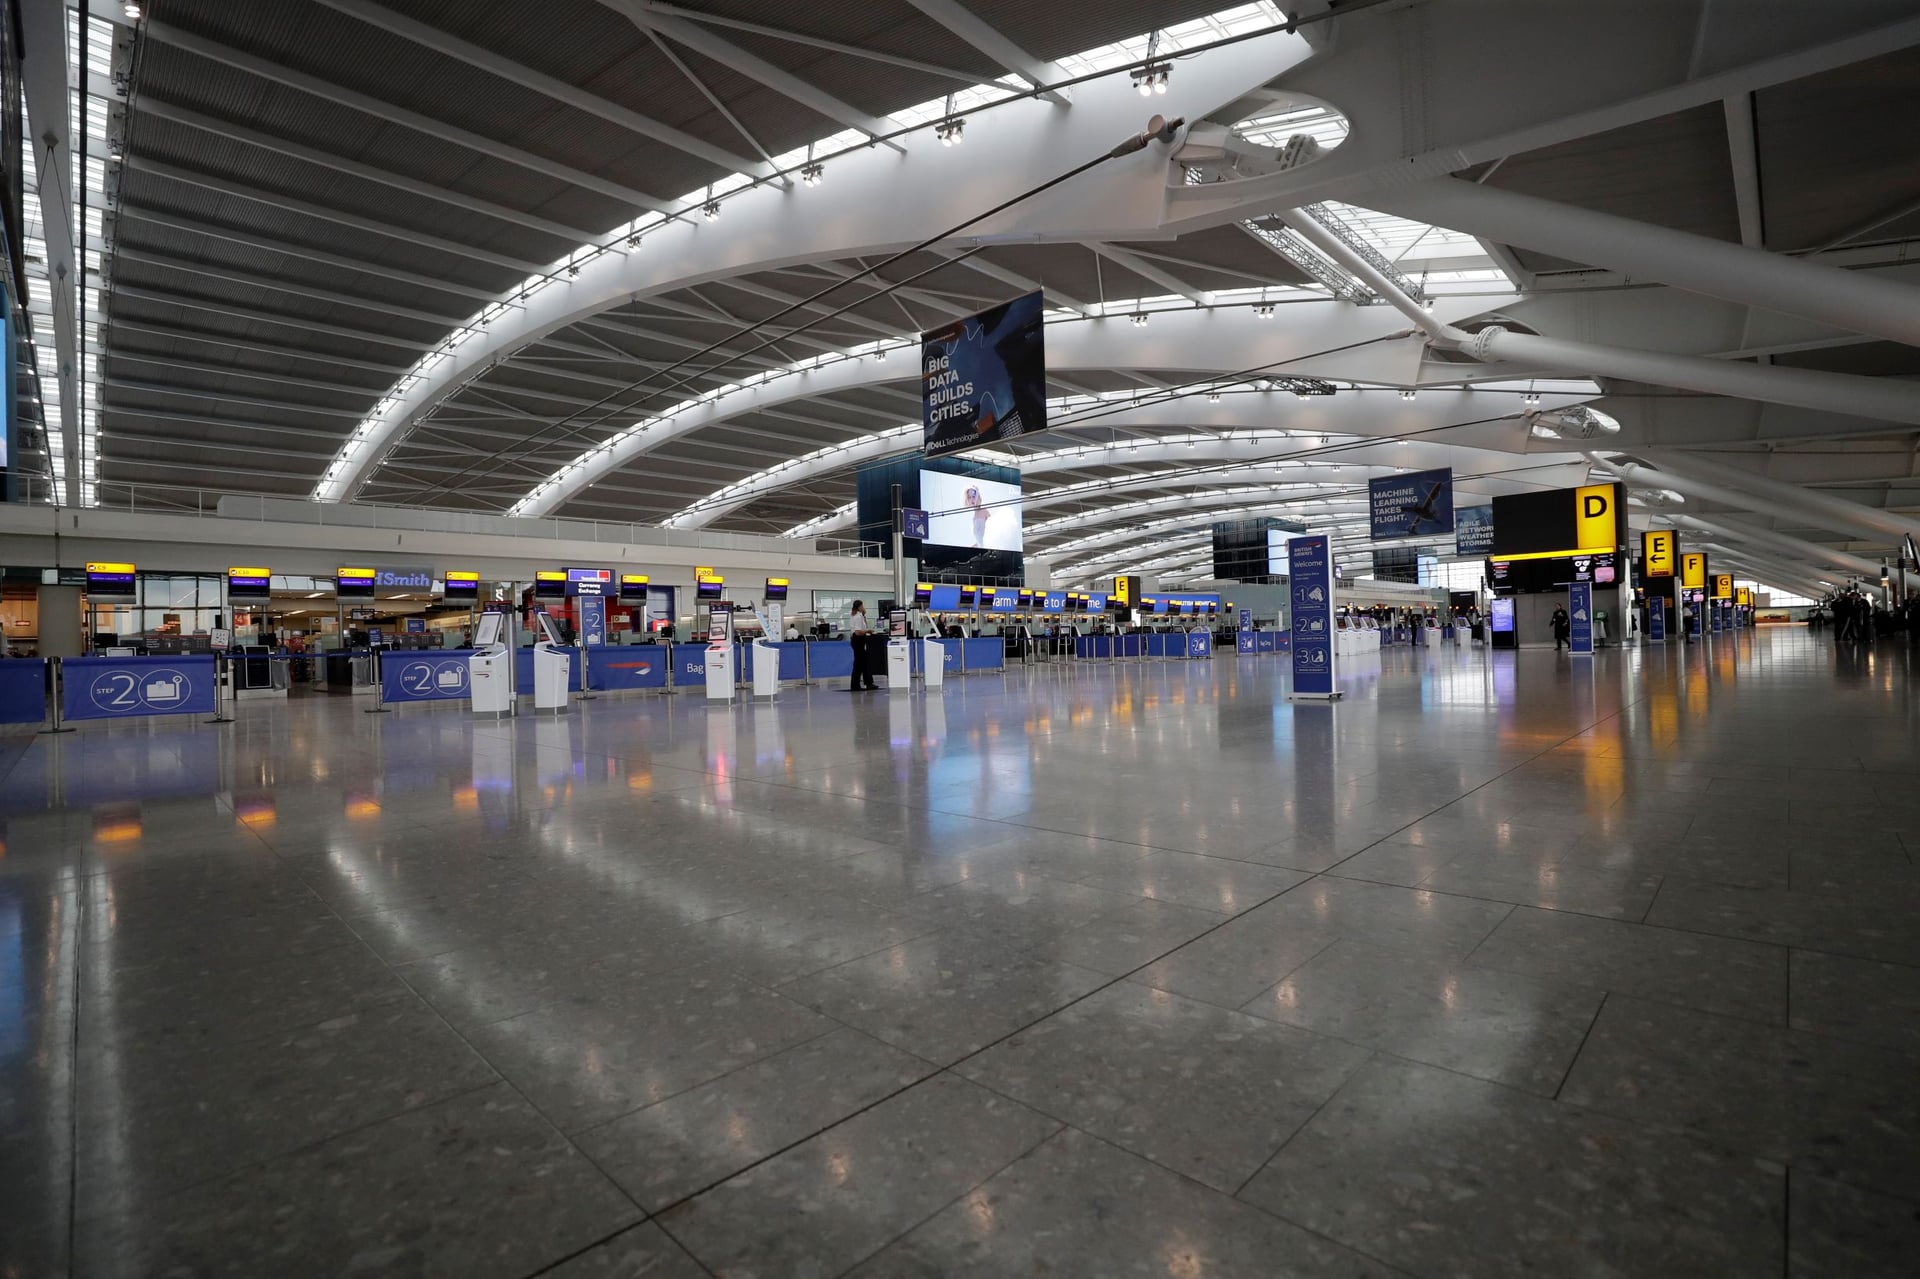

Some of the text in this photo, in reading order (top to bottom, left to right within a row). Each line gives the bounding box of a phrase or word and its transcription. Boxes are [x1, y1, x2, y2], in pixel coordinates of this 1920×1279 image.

[928, 355, 950, 373] BIG
[929, 369, 959, 389] DATA
[929, 382, 974, 407] BUILDS
[929, 401, 974, 423] CITIES.
[946, 432, 980, 447] Technologies
[1373, 487, 1415, 500] MACHINE
[1374, 496, 1418, 508] LEARNING
[1584, 495, 1607, 518] D
[1374, 506, 1402, 516] TAKES
[1374, 514, 1408, 524] FLIGHT.
[1460, 539, 1494, 547] STORMS.
[1653, 537, 1665, 553] E
[1294, 560, 1323, 568] Welcome
[1689, 558, 1697, 570] F
[1119, 580, 1125, 591] E
[1719, 577, 1729, 586] G
[1300, 588, 1305, 601] 1
[1051, 599, 1060, 608] to
[591, 613, 601, 628] 2
[1300, 618, 1308, 632] 2
[1300, 650, 1309, 664] 3
[687, 663, 704, 675] Bag
[414, 665, 431, 691] 2
[111, 675, 135, 705] 2
